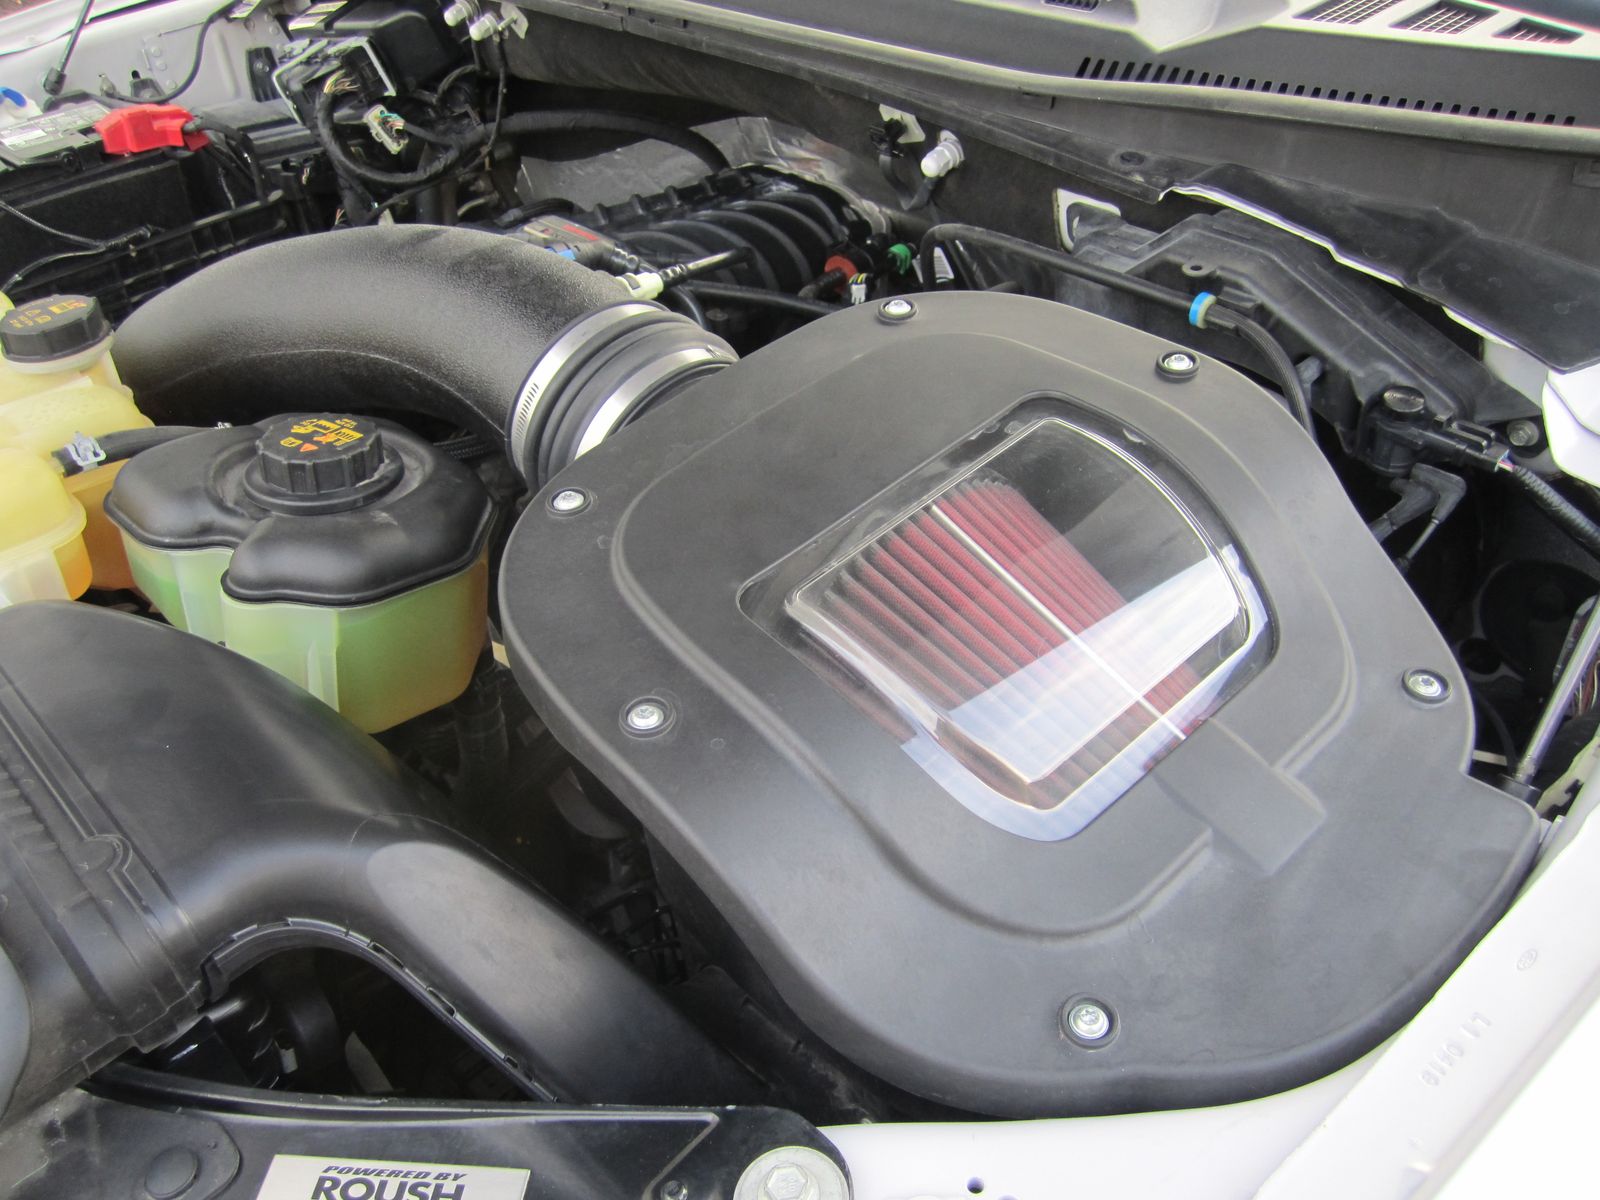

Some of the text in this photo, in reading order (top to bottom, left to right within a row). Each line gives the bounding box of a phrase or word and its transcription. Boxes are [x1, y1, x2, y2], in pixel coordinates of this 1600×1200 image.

[322, 1165, 468, 1182] POWERED BY
[310, 1175, 466, 1200] ROUSH
